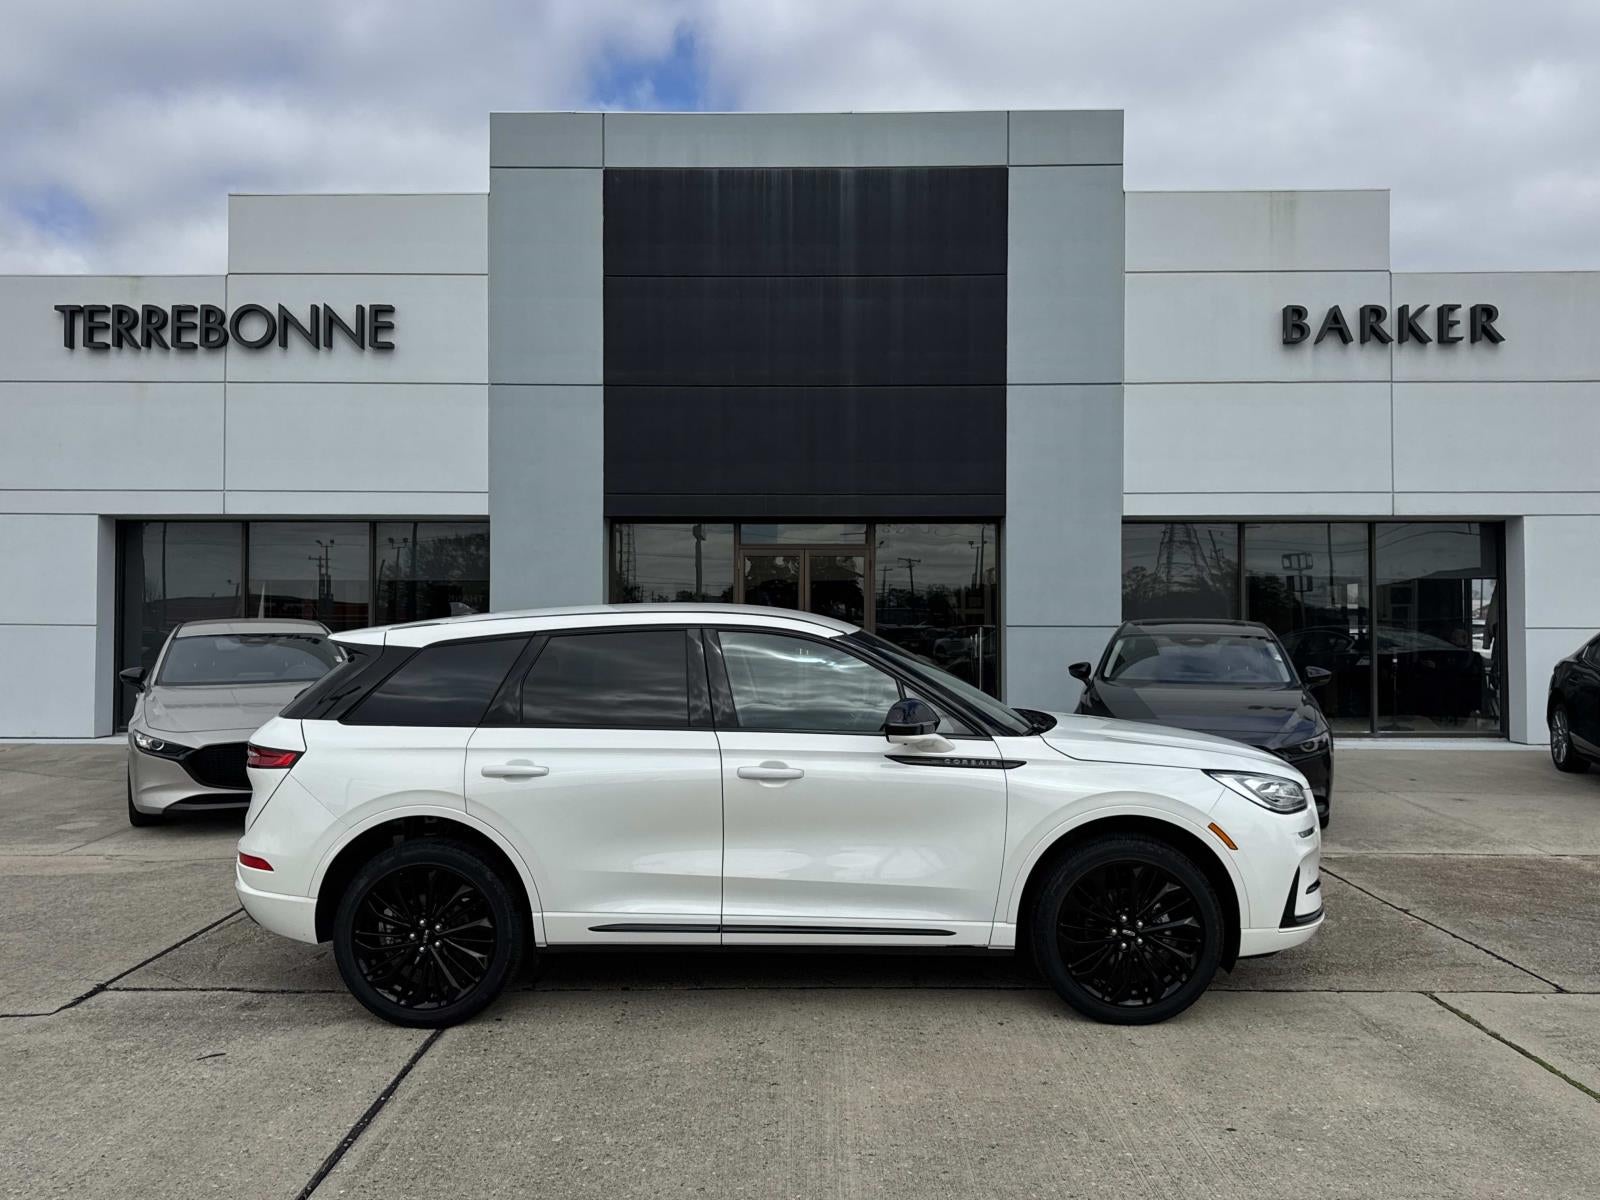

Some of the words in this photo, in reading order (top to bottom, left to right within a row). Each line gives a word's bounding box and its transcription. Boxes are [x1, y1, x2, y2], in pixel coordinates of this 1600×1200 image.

[54, 303, 395, 350] TERREBONNE
[1282, 304, 1506, 345] BARKER
[944, 758, 998, 766] CORSAIR
